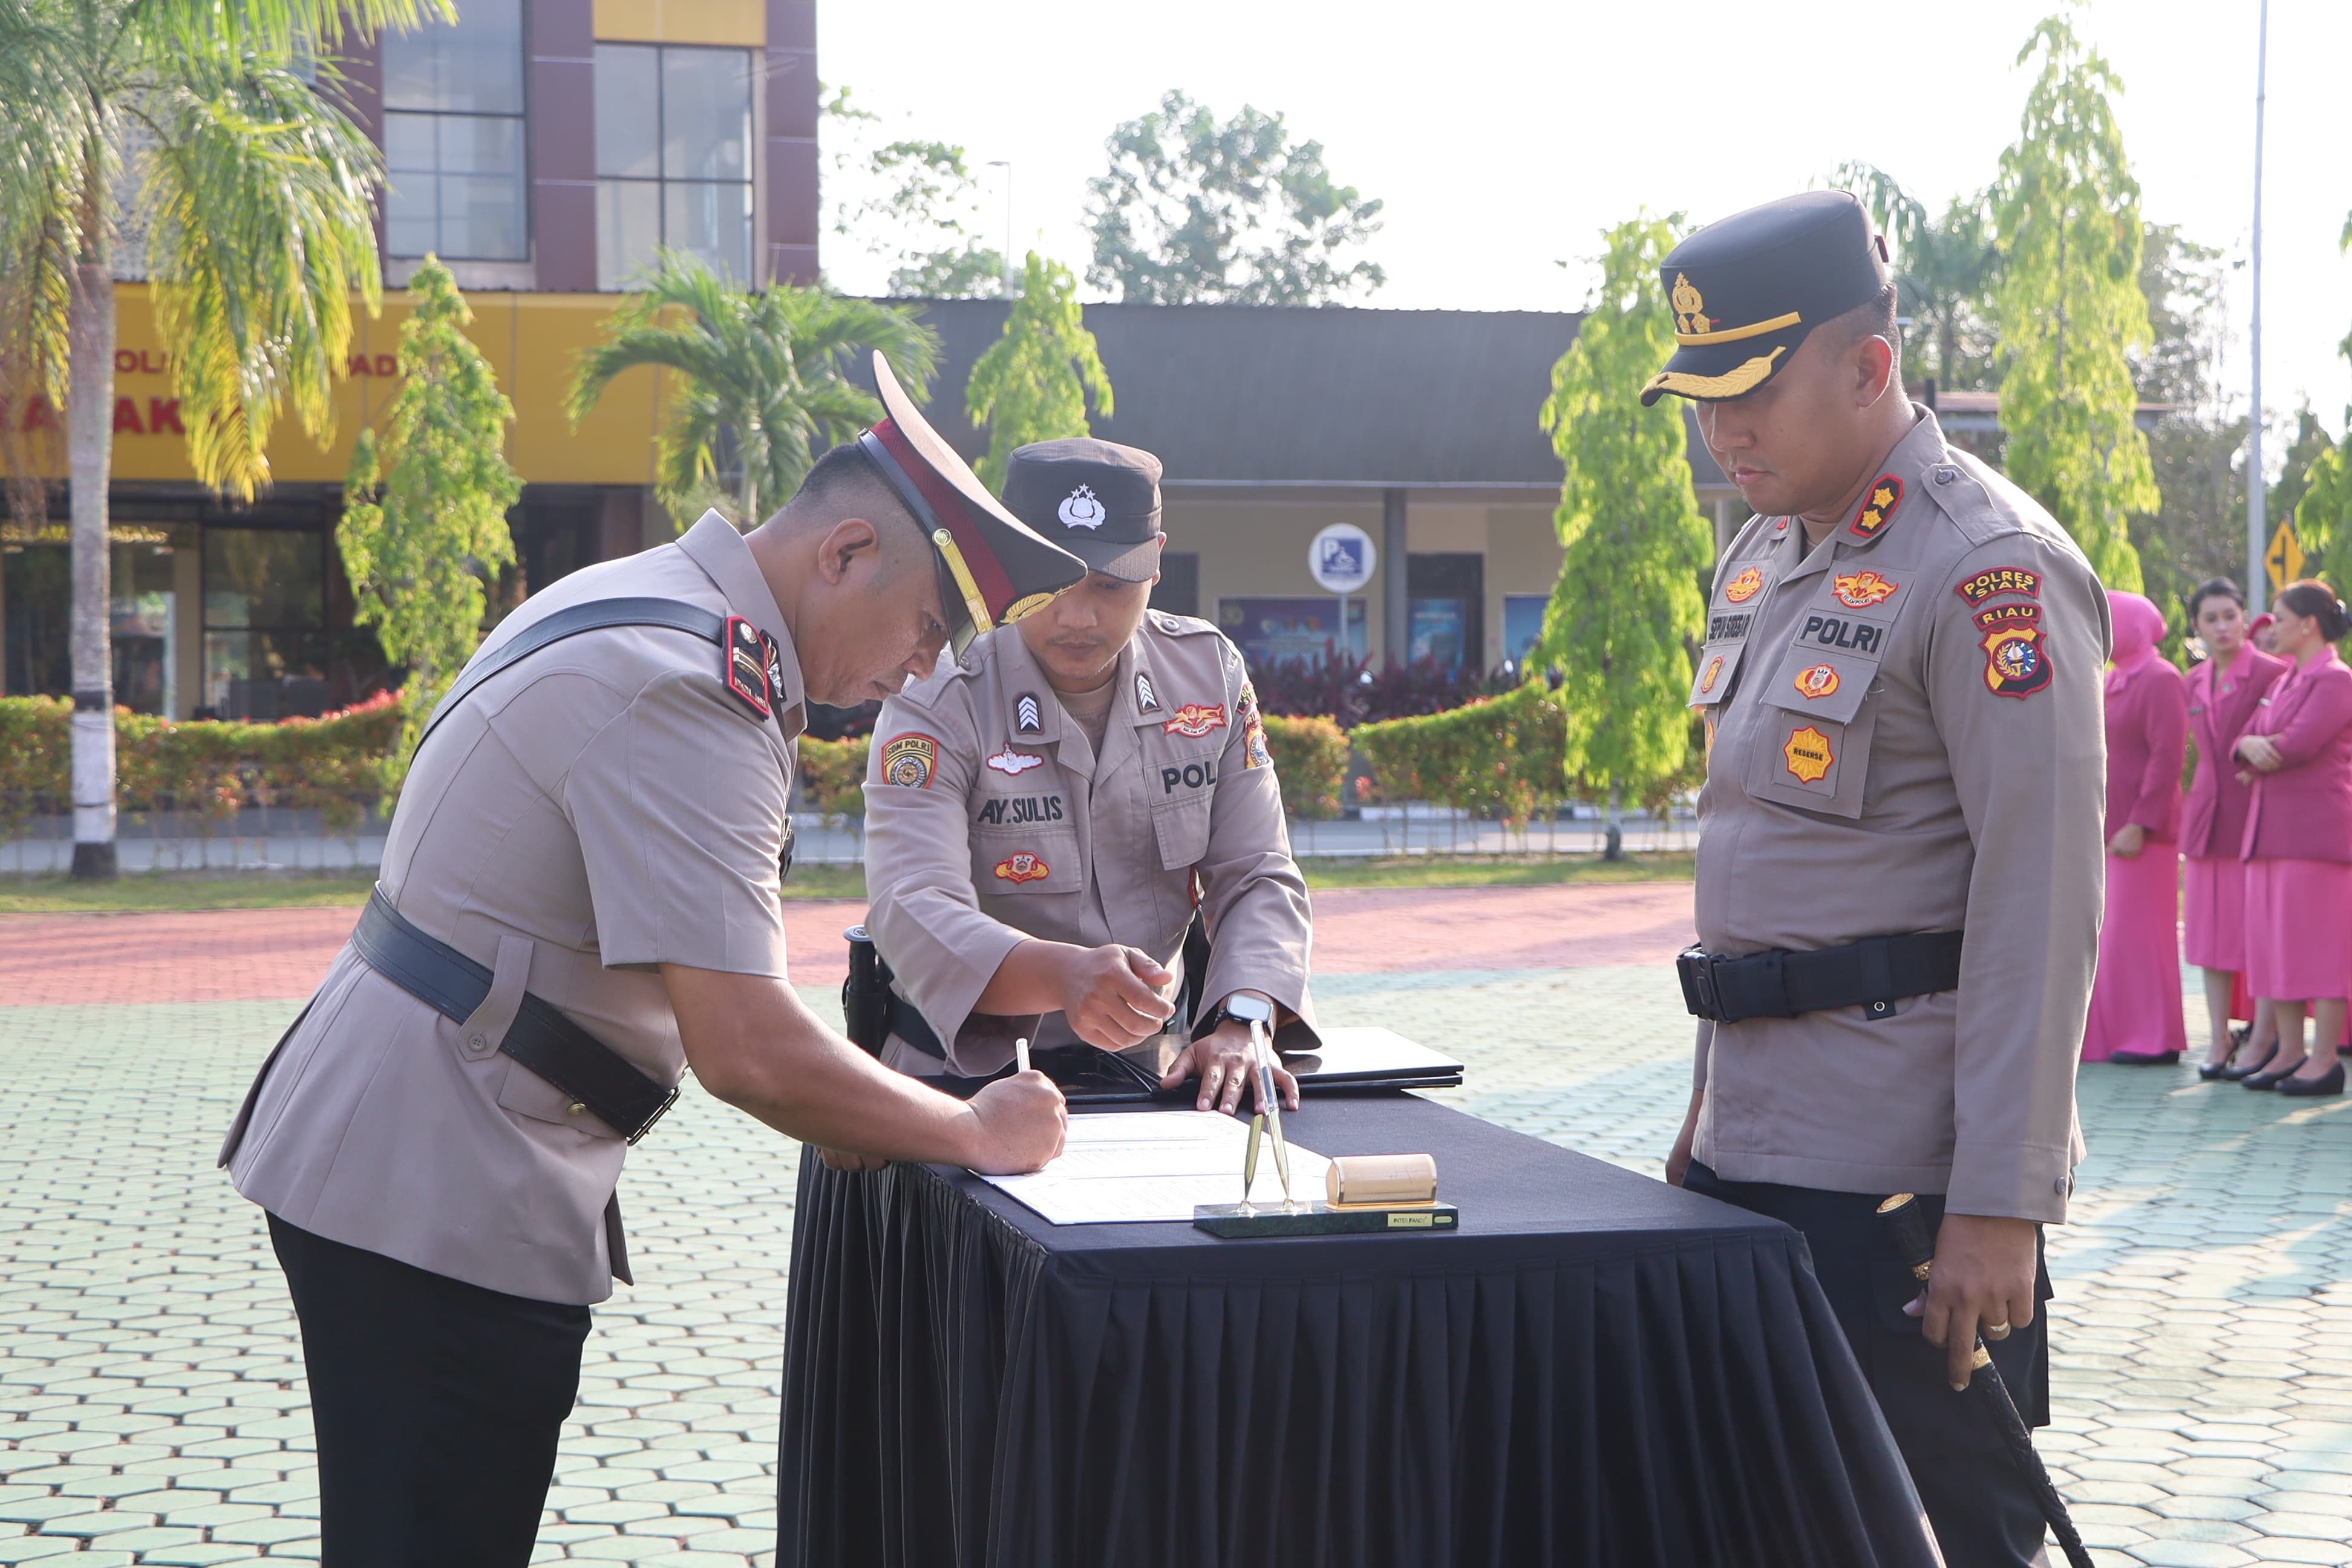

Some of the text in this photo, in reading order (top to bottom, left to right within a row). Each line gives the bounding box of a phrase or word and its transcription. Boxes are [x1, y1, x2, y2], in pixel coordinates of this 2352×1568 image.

[1964, 571, 2034, 595] POLRES
[1976, 581, 2028, 598] SIAK
[1982, 607, 2033, 624] RIAU
[1800, 616, 1883, 655] POLRI
[887, 740, 930, 756] SDM POLRI
[1794, 747, 1823, 761] RESERSE
[1161, 761, 1217, 794] POL
